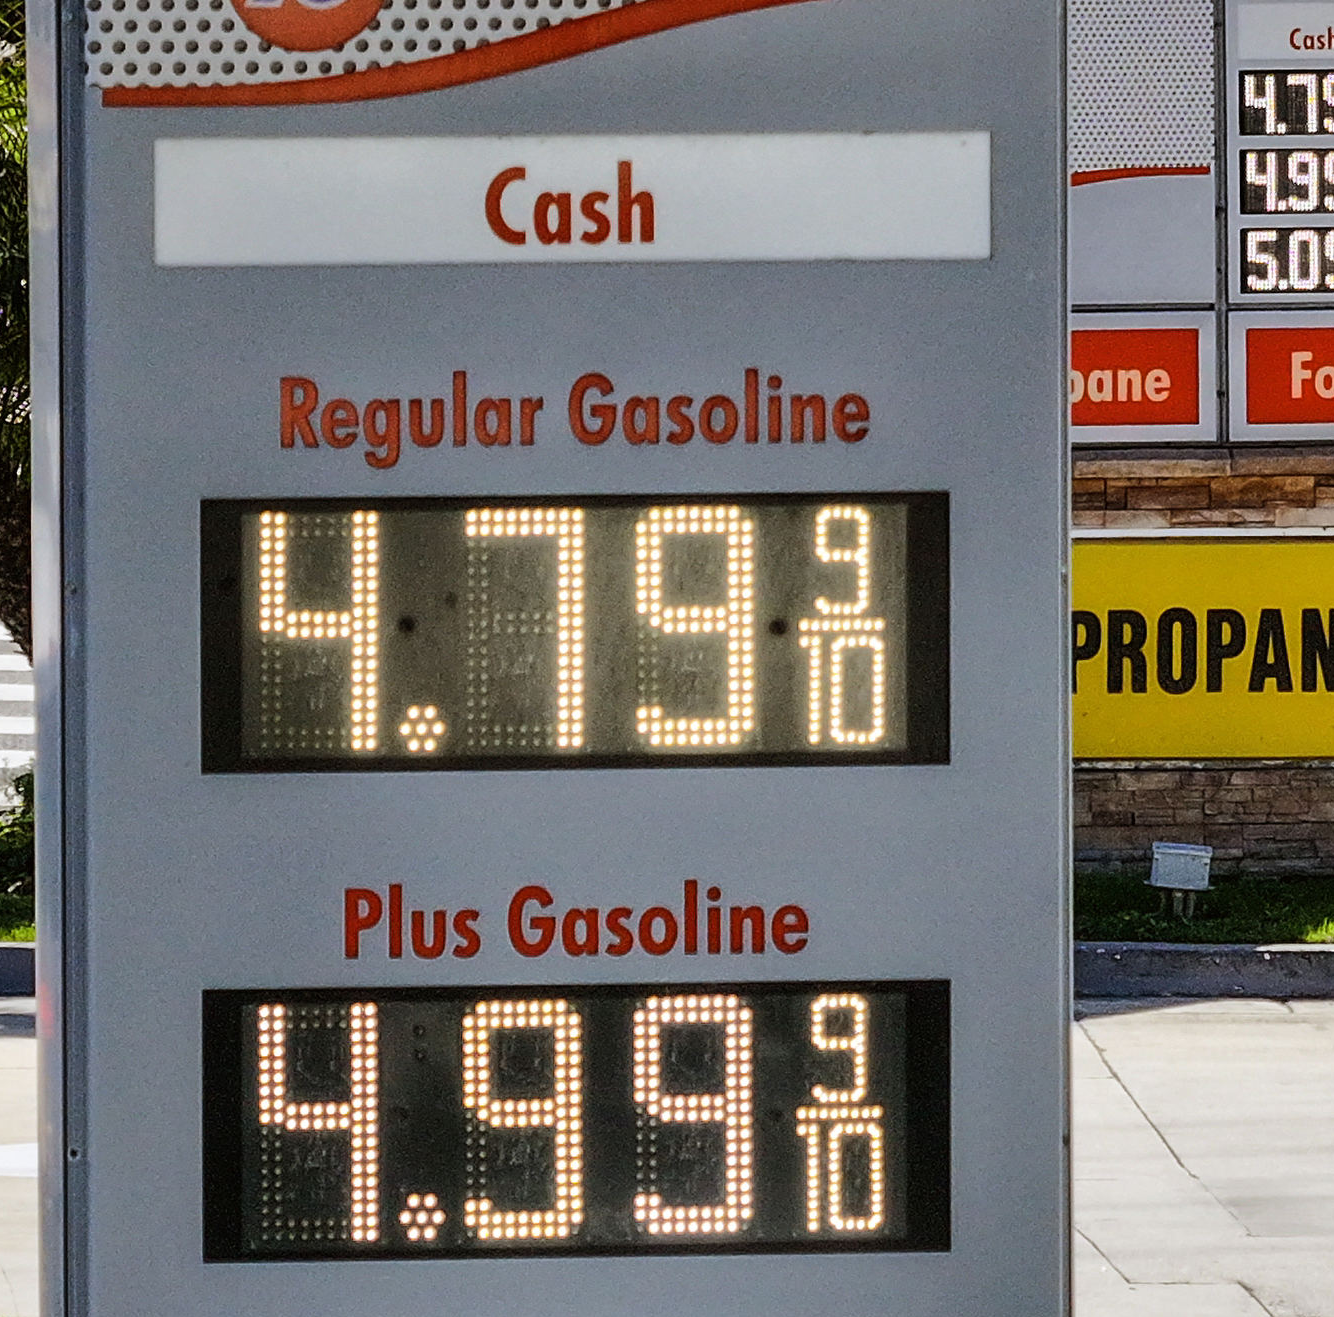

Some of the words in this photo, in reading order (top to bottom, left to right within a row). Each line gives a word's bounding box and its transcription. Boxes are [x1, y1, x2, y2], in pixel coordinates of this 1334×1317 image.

[484, 160, 655, 245] Cash
[279, 371, 543, 470] Regular
[568, 368, 871, 448] Gasoline
[344, 883, 482, 961] Plus
[507, 880, 810, 957] Gasoline
